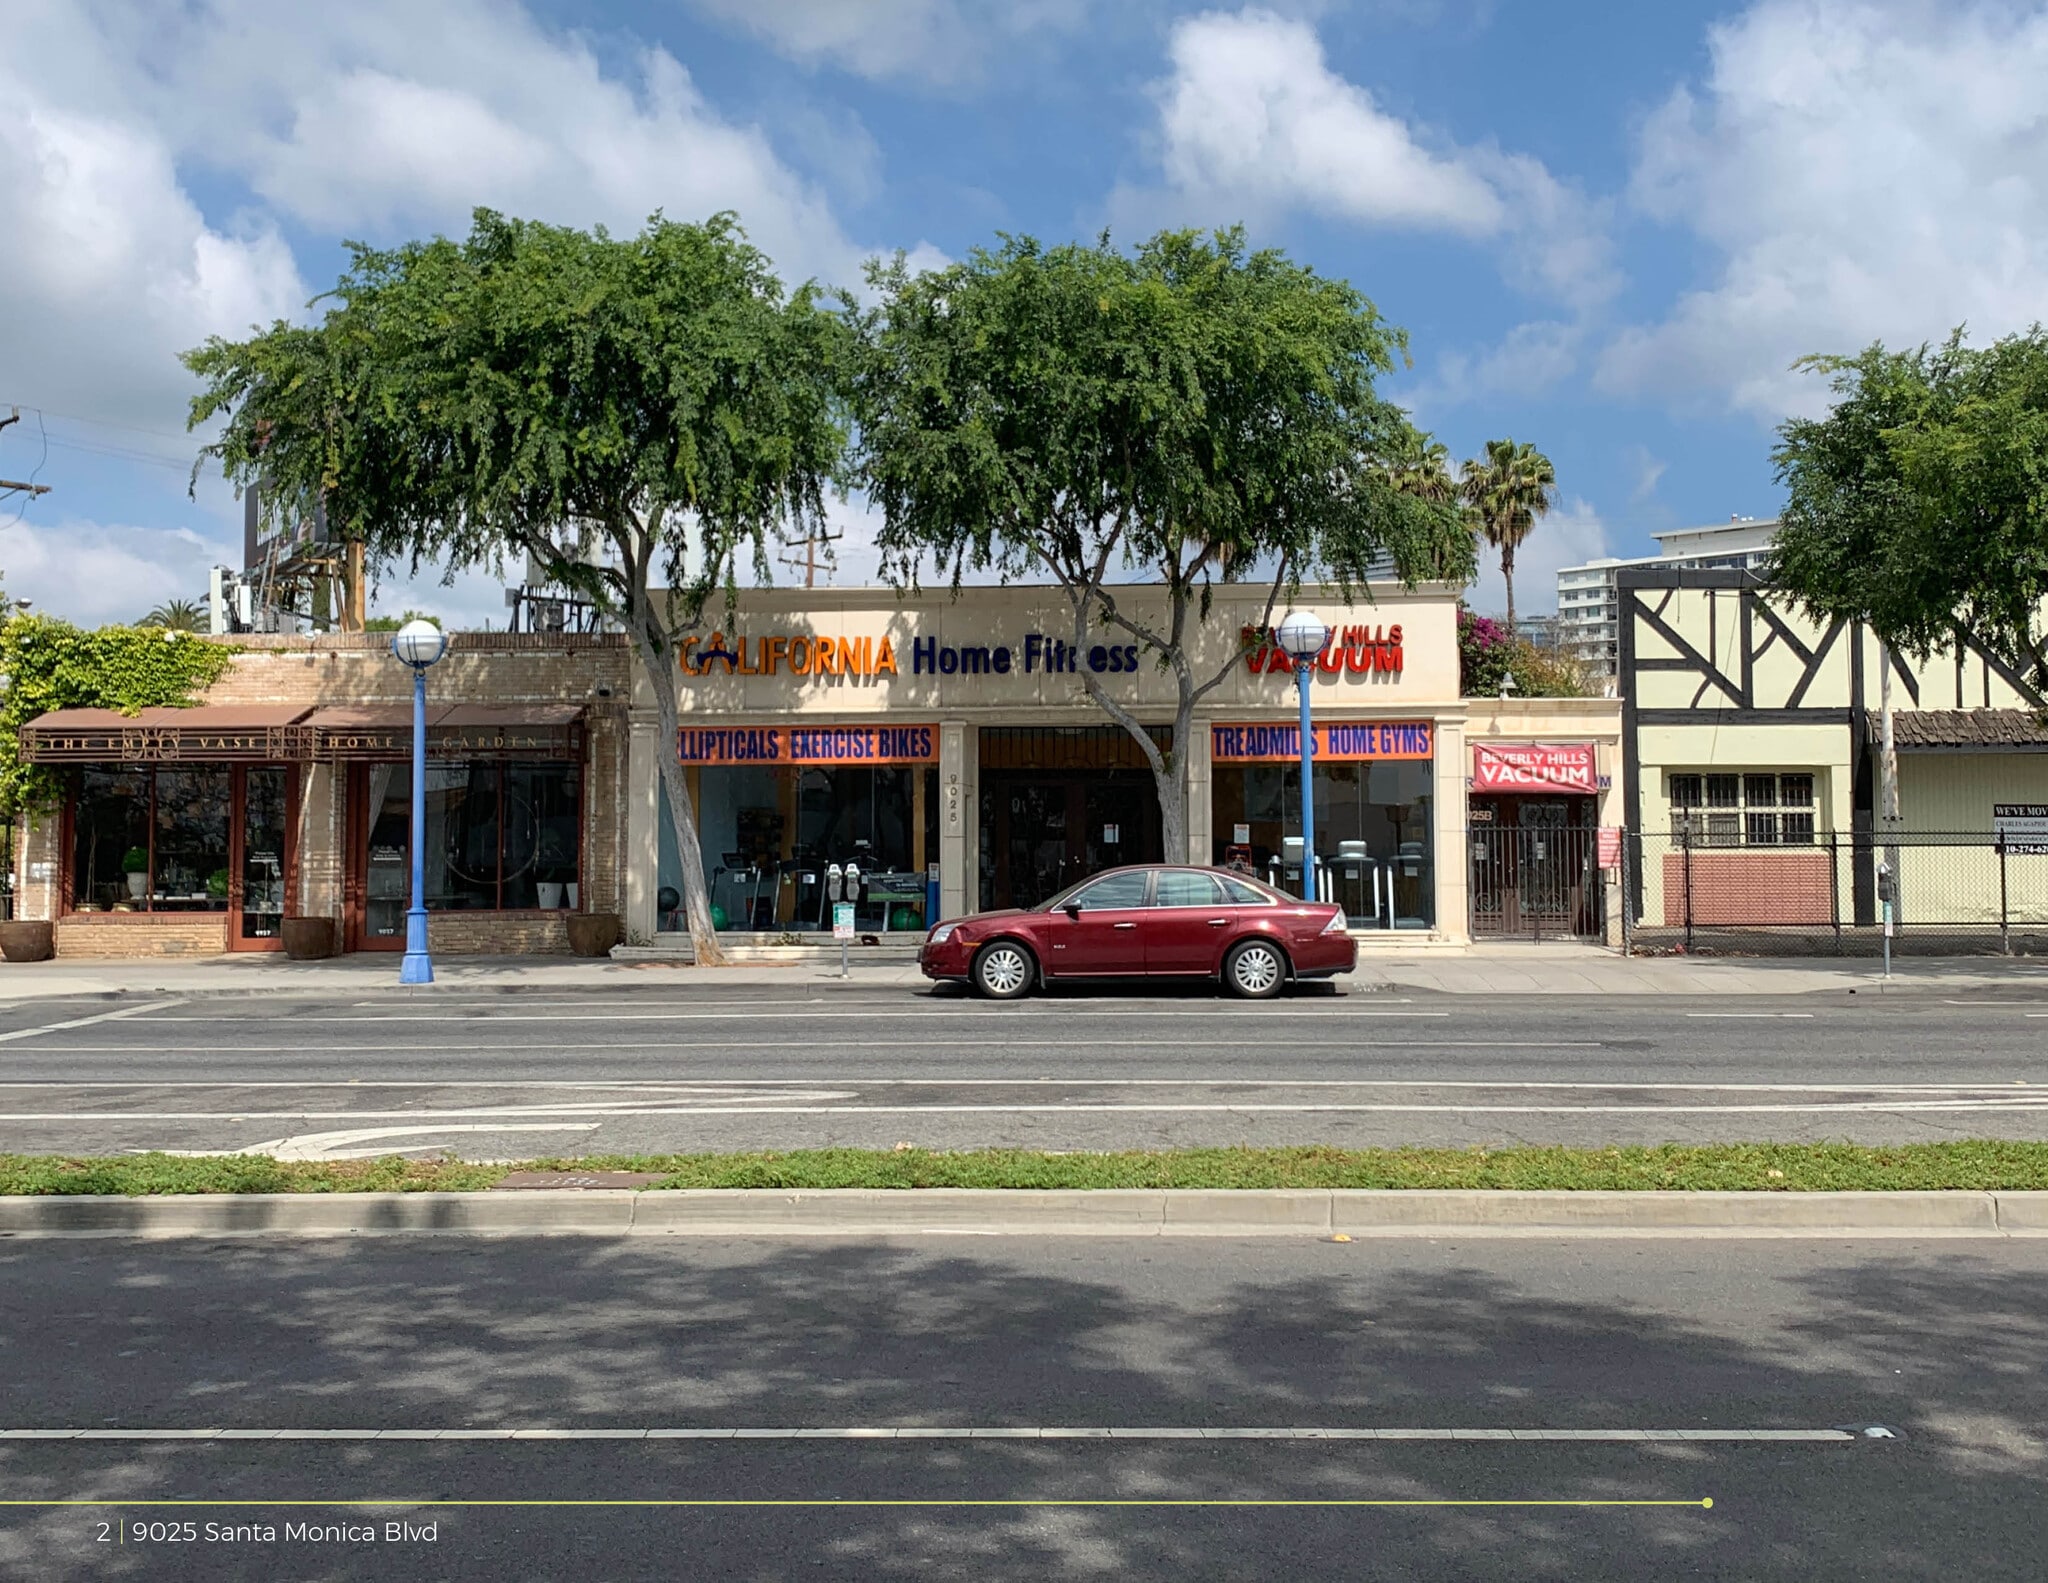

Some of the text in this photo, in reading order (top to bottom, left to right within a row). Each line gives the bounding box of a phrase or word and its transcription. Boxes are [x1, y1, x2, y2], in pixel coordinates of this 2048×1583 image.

[1343, 624, 1403, 646] HILLS
[679, 631, 897, 676] CALIFORNIA
[913, 636, 1011, 674] Home
[49, 737, 256, 749] THE EMPTY VASE
[328, 736, 393, 748] HOME
[677, 728, 931, 760] LLIPTICALS EXERCISE BIKES
[1213, 723, 1429, 757] TREADMILS HOME GYMS
[1481, 752, 1588, 765] BEVERLY HILLS
[1480, 765, 1589, 785] VACUUM
[1995, 806, 2026, 816] WE'VE
